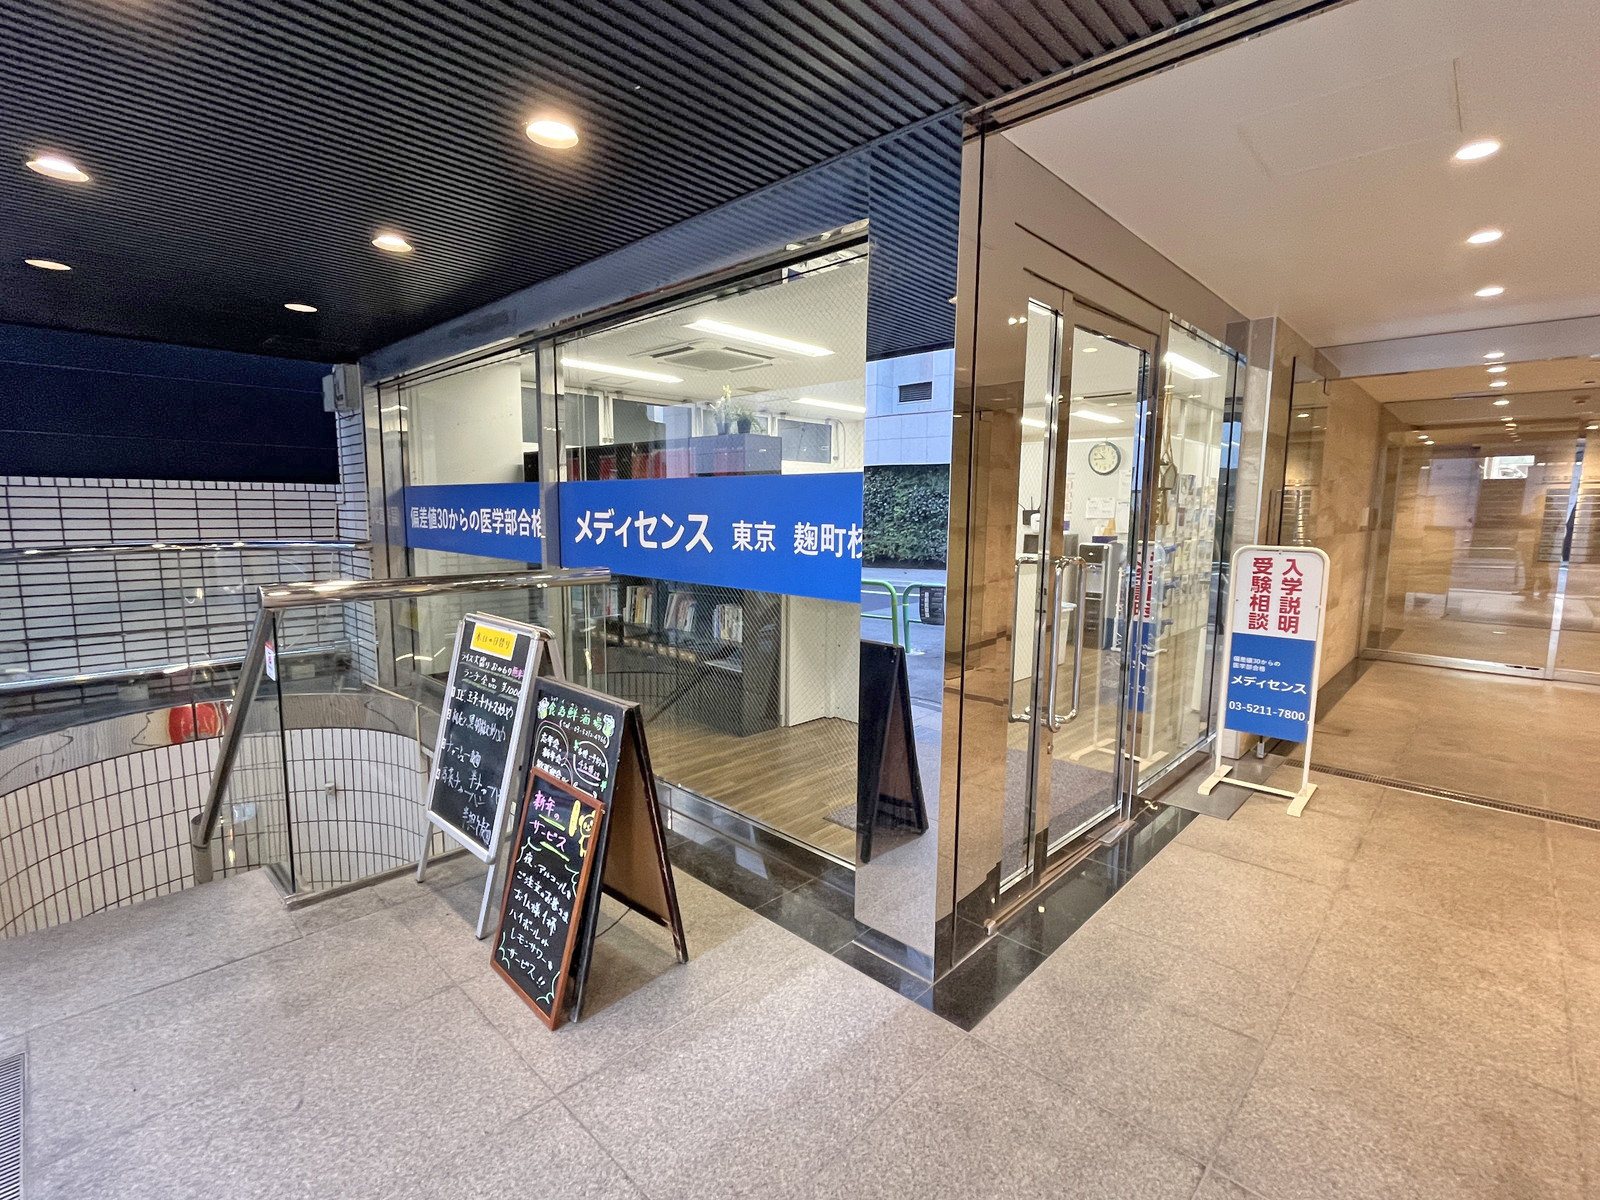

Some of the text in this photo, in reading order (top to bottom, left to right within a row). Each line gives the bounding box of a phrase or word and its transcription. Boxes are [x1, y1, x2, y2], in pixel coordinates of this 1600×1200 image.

[411, 507, 541, 538] 偏差値30からの医学部合格
[575, 508, 714, 553] メディセンス
[732, 520, 776, 552] 東京
[1248, 557, 1273, 631] 受験相談
[1278, 558, 1303, 634] 入学説明
[1232, 662, 1266, 672] 医学部合格
[1233, 655, 1281, 667] 偏差値30からの
[1231, 675, 1307, 694] メディセンス
[1228, 701, 1306, 722] 03-5211-7800
[533, 790, 560, 821] 新年の
[529, 819, 567, 852] サービス
